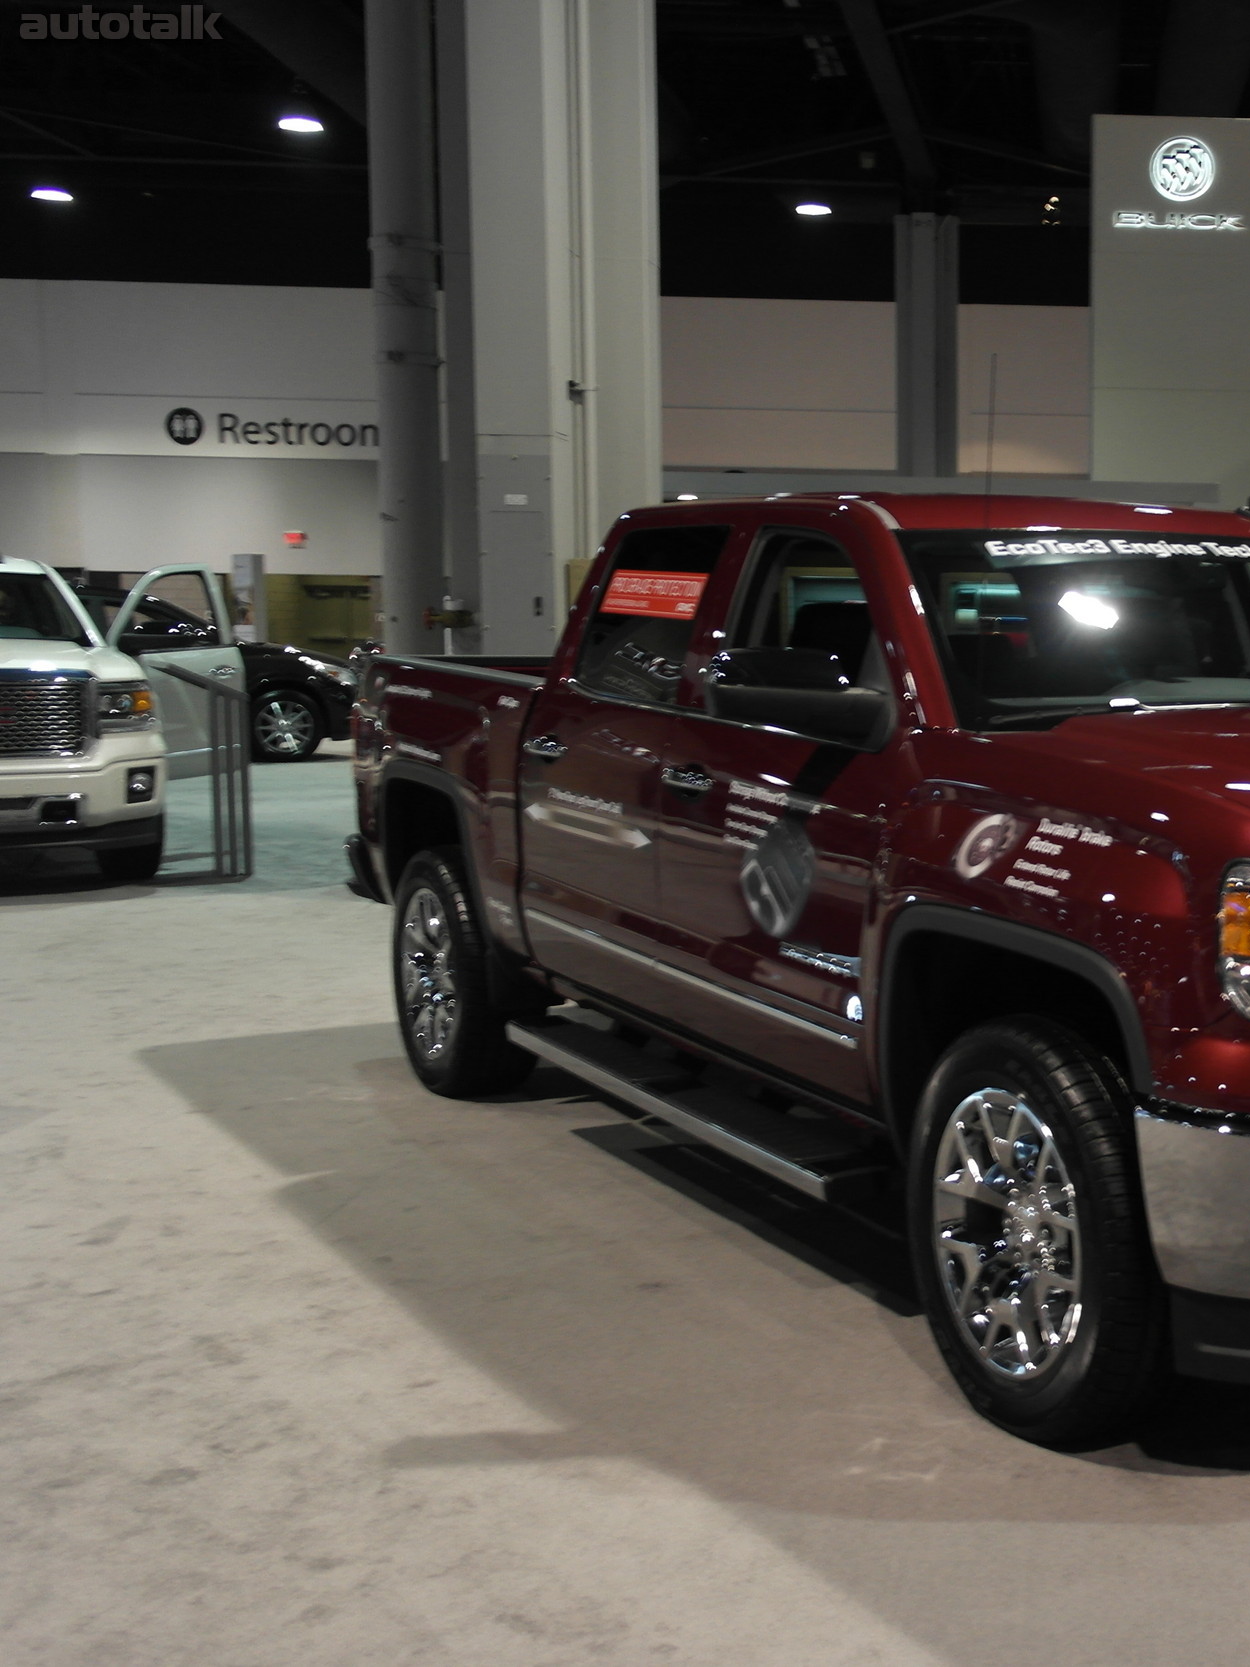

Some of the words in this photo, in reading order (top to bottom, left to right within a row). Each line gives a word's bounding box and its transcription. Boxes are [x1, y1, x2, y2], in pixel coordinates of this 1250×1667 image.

[1112, 210, 1247, 230] BUICK
[983, 539, 1111, 556] EcoTec3
[1109, 539, 1205, 558] Engine
